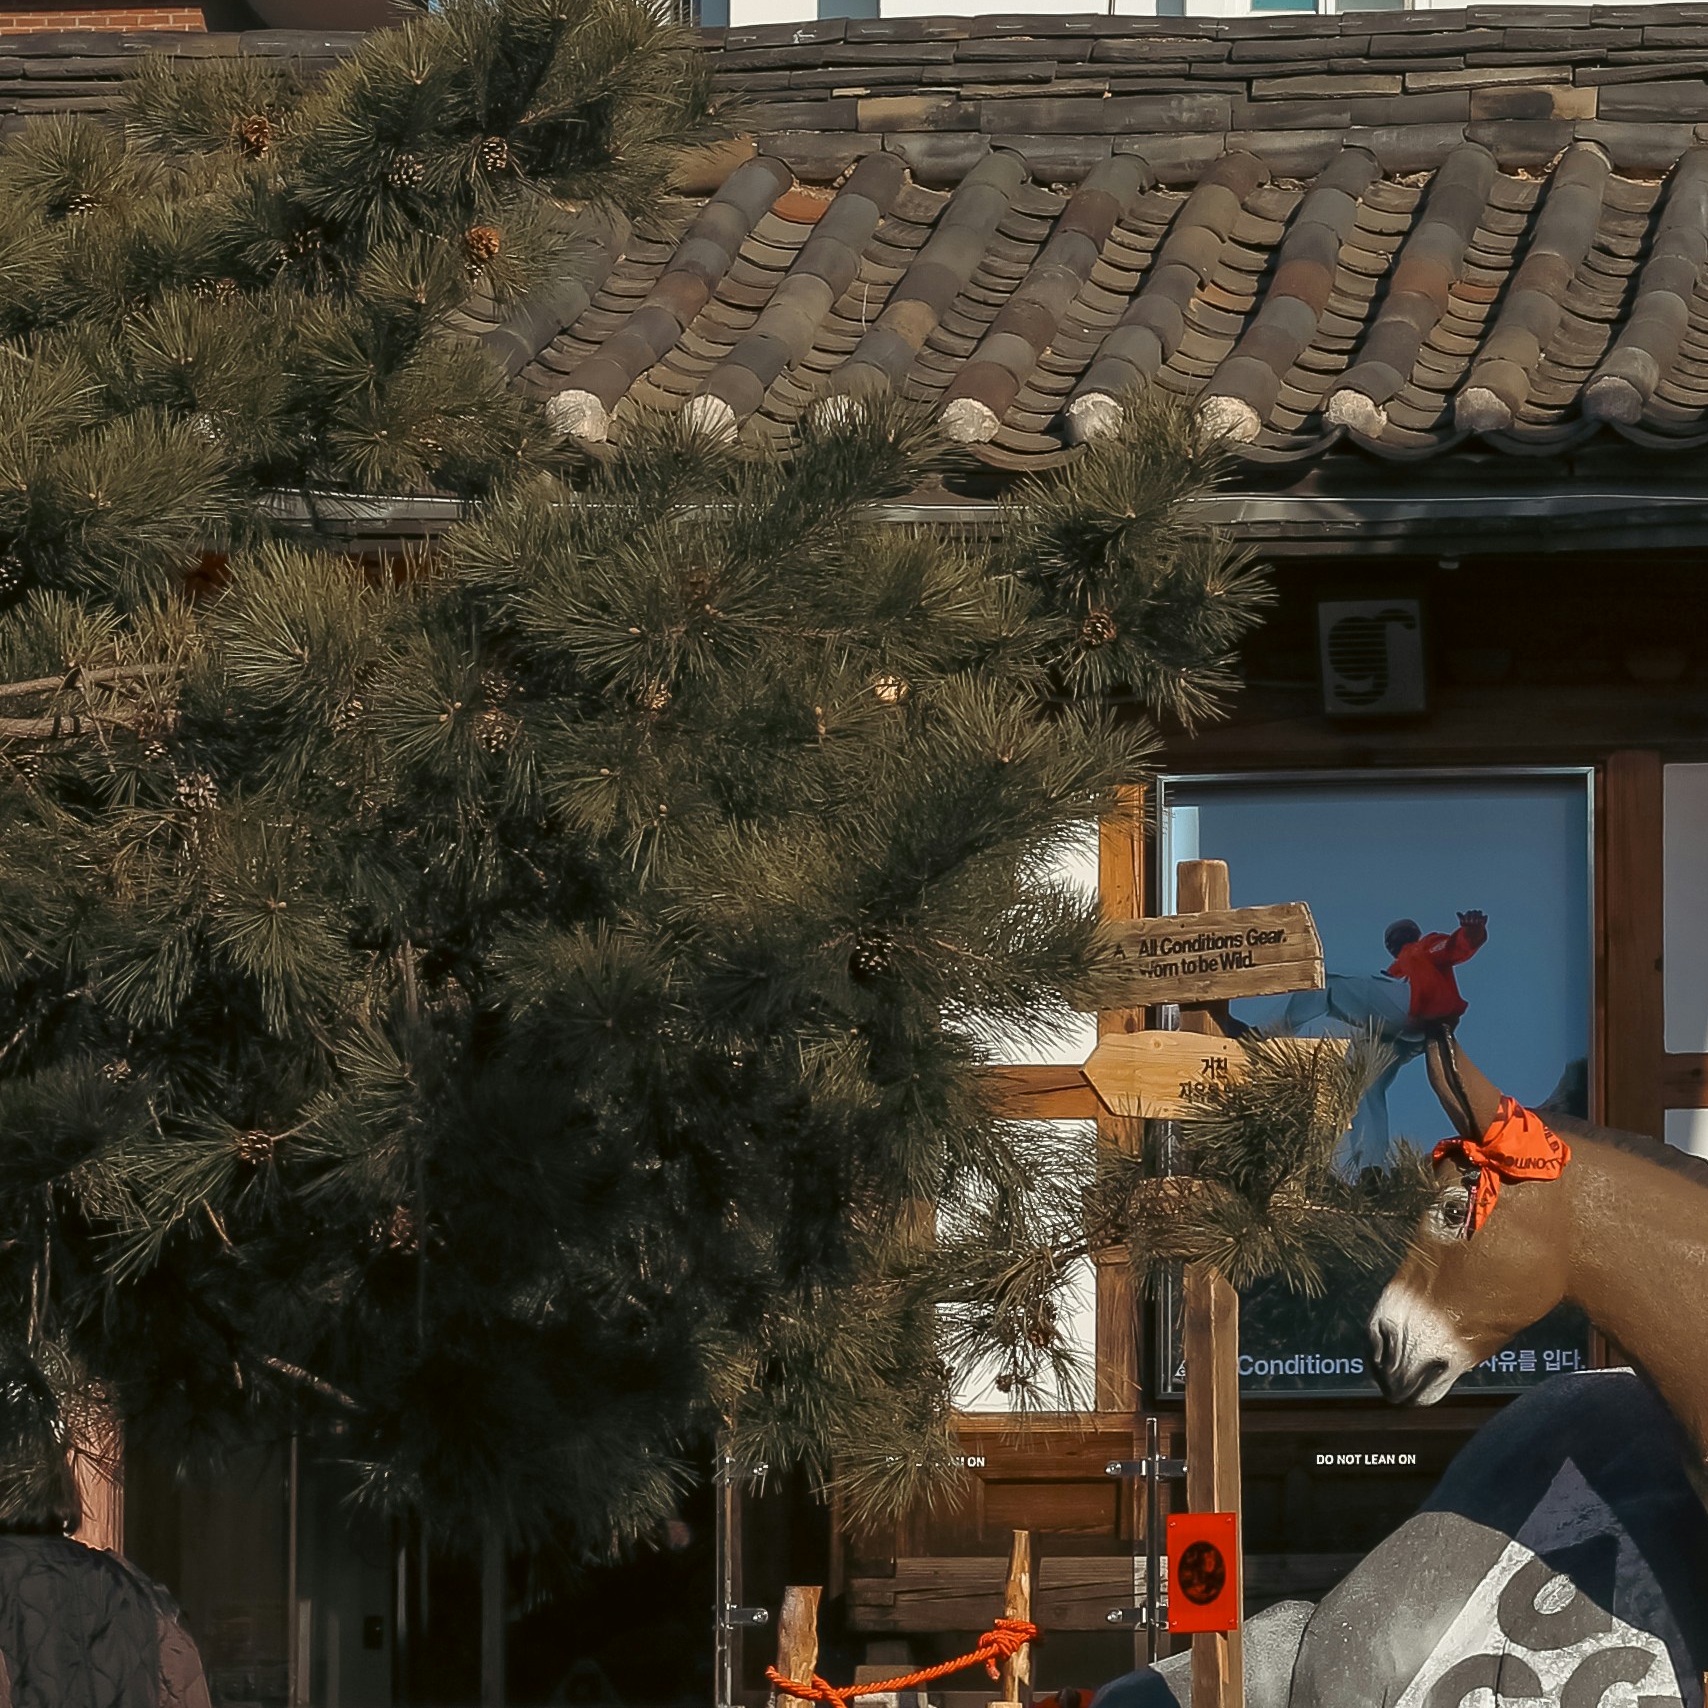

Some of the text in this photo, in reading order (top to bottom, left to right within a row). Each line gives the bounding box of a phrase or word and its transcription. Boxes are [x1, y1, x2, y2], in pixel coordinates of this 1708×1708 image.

[1138, 938, 1158, 957] All
[1160, 932, 1244, 956] Conditions
[1246, 928, 1287, 948] Gear.
[1181, 959, 1198, 976] to
[1198, 955, 1218, 972] be
[1201, 1056, 1228, 1079] 거친
[1238, 1353, 1364, 1376] Conditions
[1543, 1349, 1586, 1372] 입다.
[967, 1456, 986, 1467] ON
[1316, 1454, 1416, 1465] DO NOT LEAN ON
